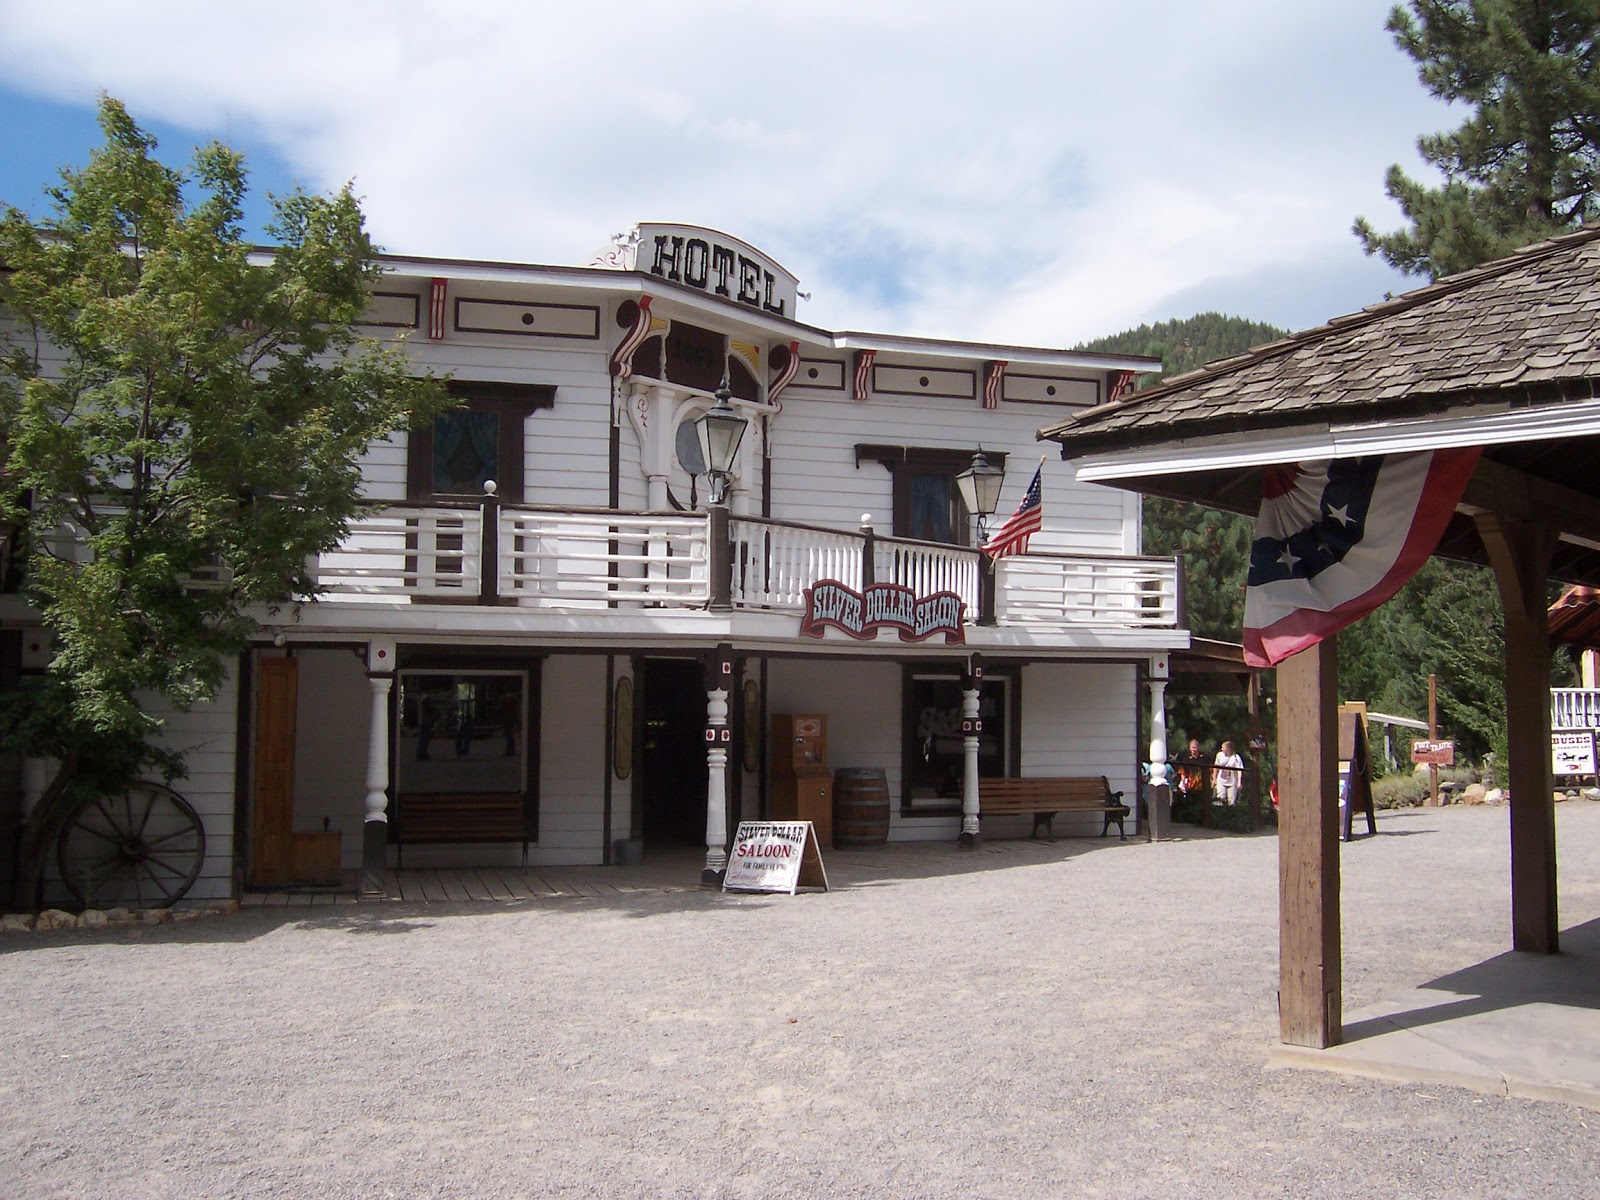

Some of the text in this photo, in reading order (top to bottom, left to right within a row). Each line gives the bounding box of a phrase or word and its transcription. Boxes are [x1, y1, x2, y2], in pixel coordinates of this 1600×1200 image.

[651, 235, 785, 316] HOTEL
[813, 586, 961, 636] SILVER DOLLAR SALOON
[1551, 736, 1590, 745] BUSES
[738, 826, 804, 844] SILVER DOLLAR
[737, 844, 792, 858] SALOON
